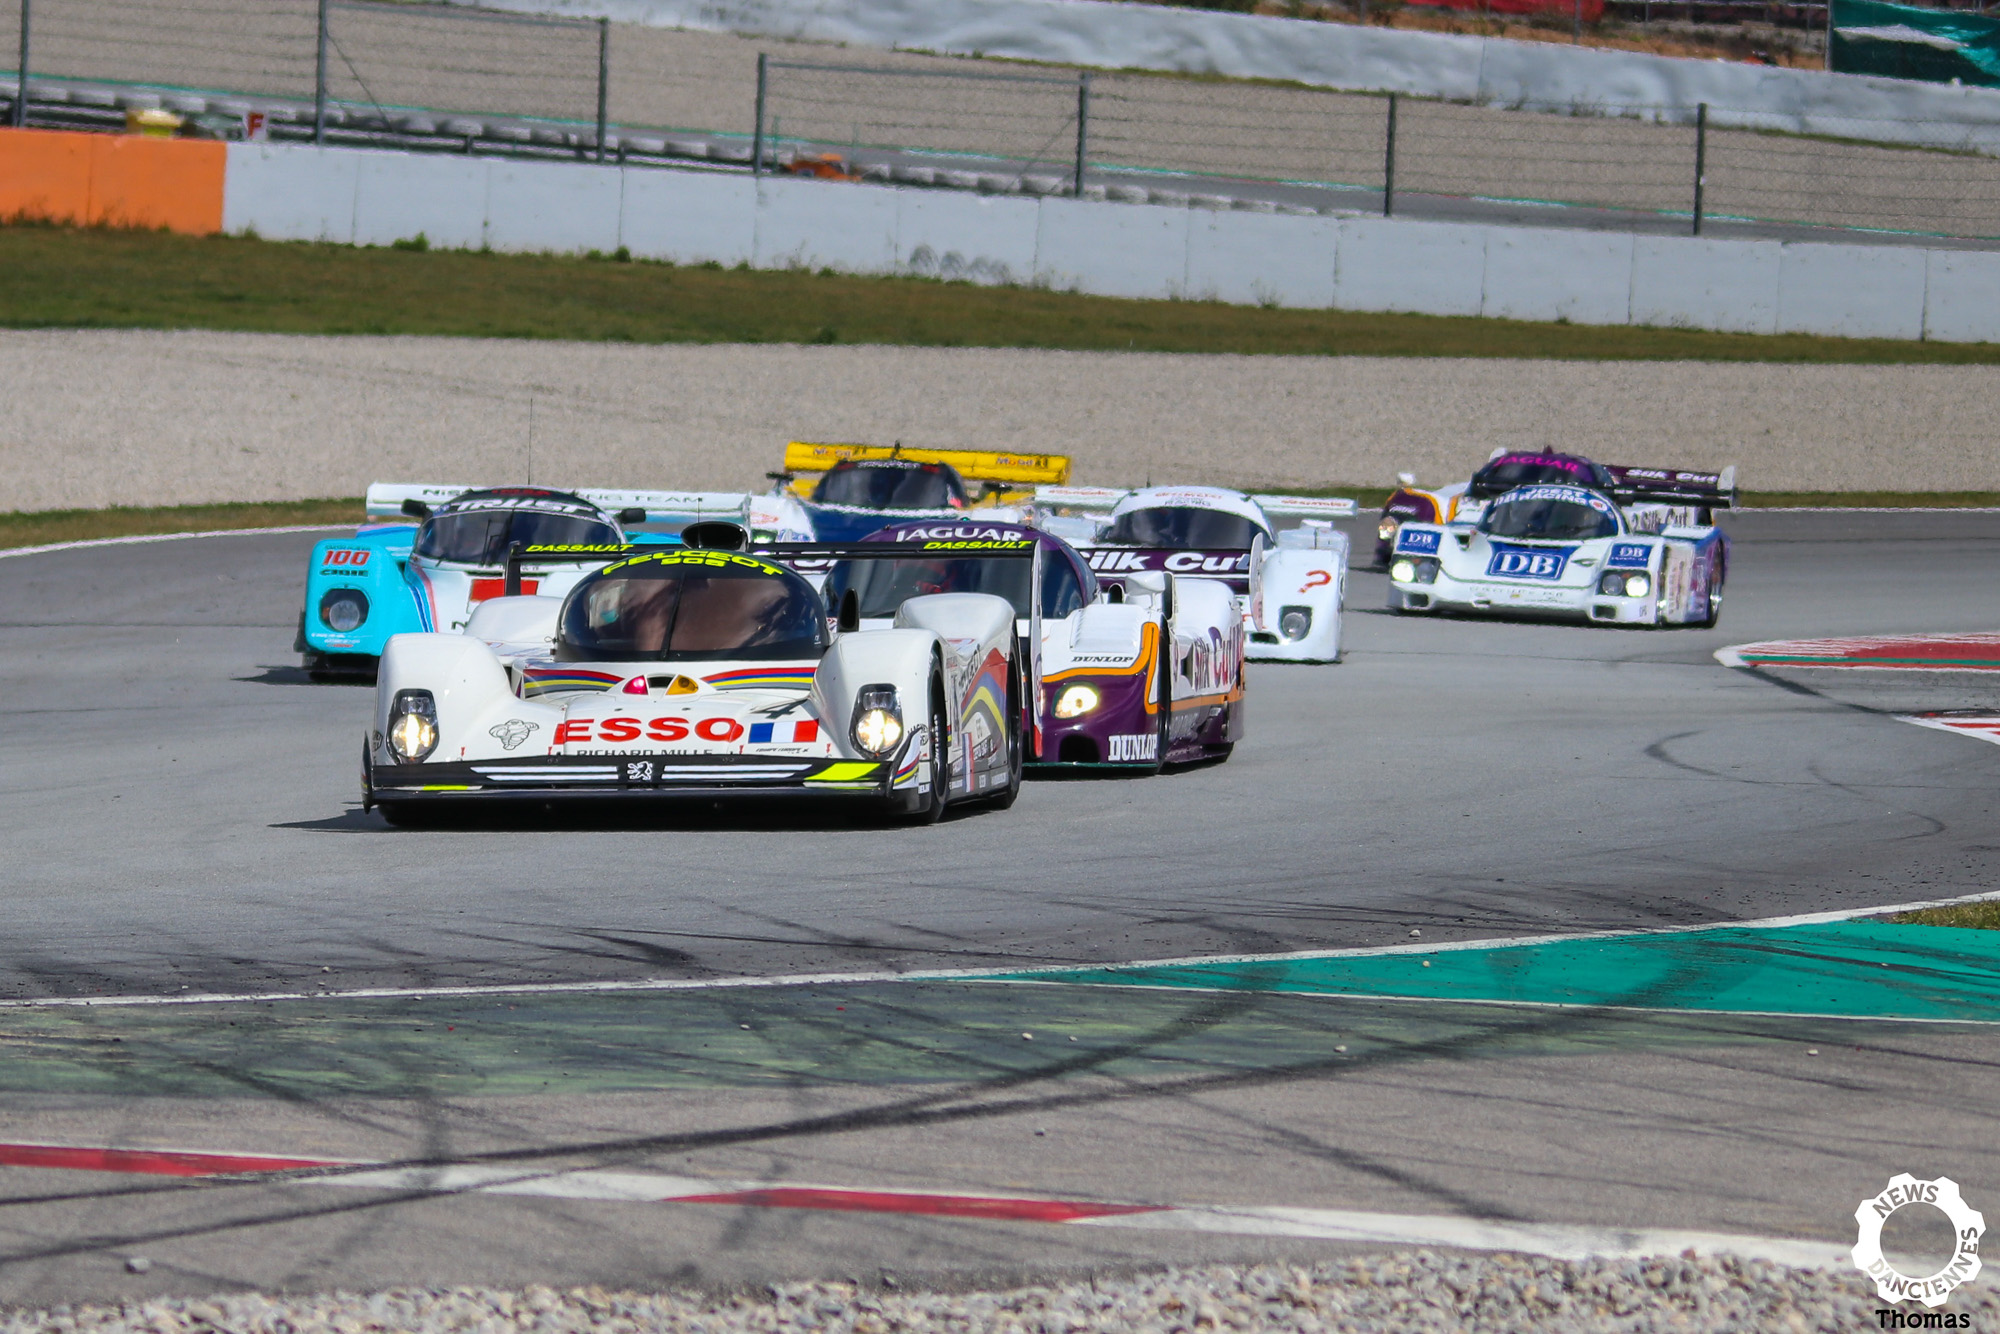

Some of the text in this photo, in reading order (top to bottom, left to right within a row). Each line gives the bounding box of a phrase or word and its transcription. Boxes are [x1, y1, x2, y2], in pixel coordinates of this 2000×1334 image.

[1493, 456, 1580, 472] JAGUAR
[1625, 469, 1668, 480] Silk
[450, 499, 595, 513] TRUST
[896, 527, 1023, 543] JAGUAR
[526, 544, 634, 553] DASSAULT
[923, 540, 1033, 550] DASSAULT
[322, 550, 371, 567] 100
[602, 549, 784, 576] PEUGEOT
[1499, 553, 1556, 575] DB
[552, 716, 745, 745] ESSO
[1107, 734, 1159, 762] DUNLOP
